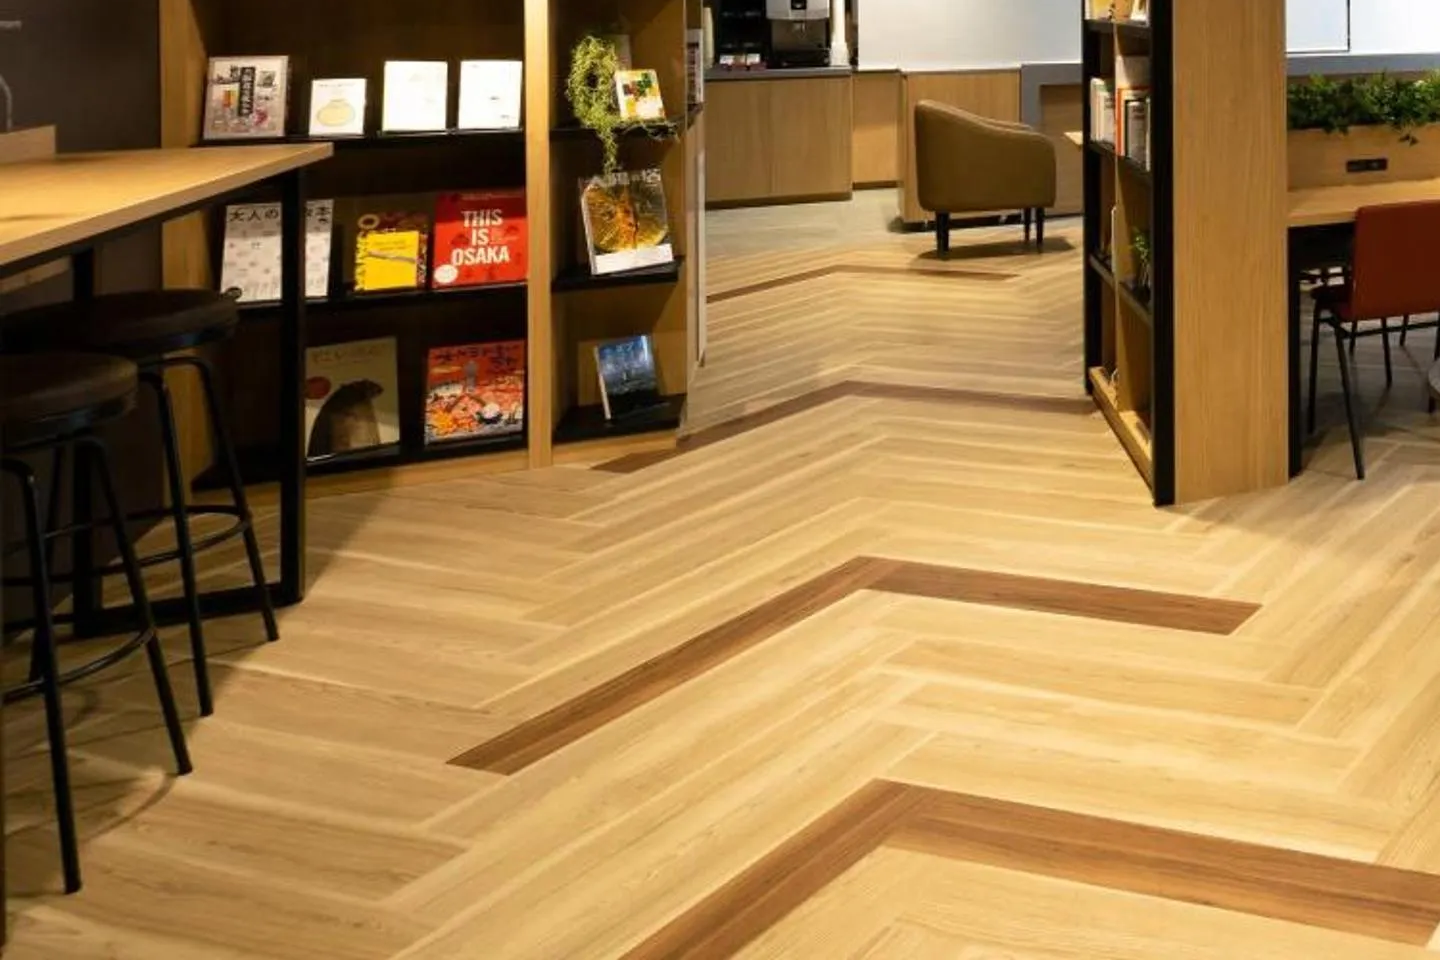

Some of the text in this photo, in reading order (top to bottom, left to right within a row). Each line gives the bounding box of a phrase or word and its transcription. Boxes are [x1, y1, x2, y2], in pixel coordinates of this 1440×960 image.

[461, 208, 503, 228] THIS
[471, 228, 490, 246] IS
[451, 245, 511, 266] OSAKA
